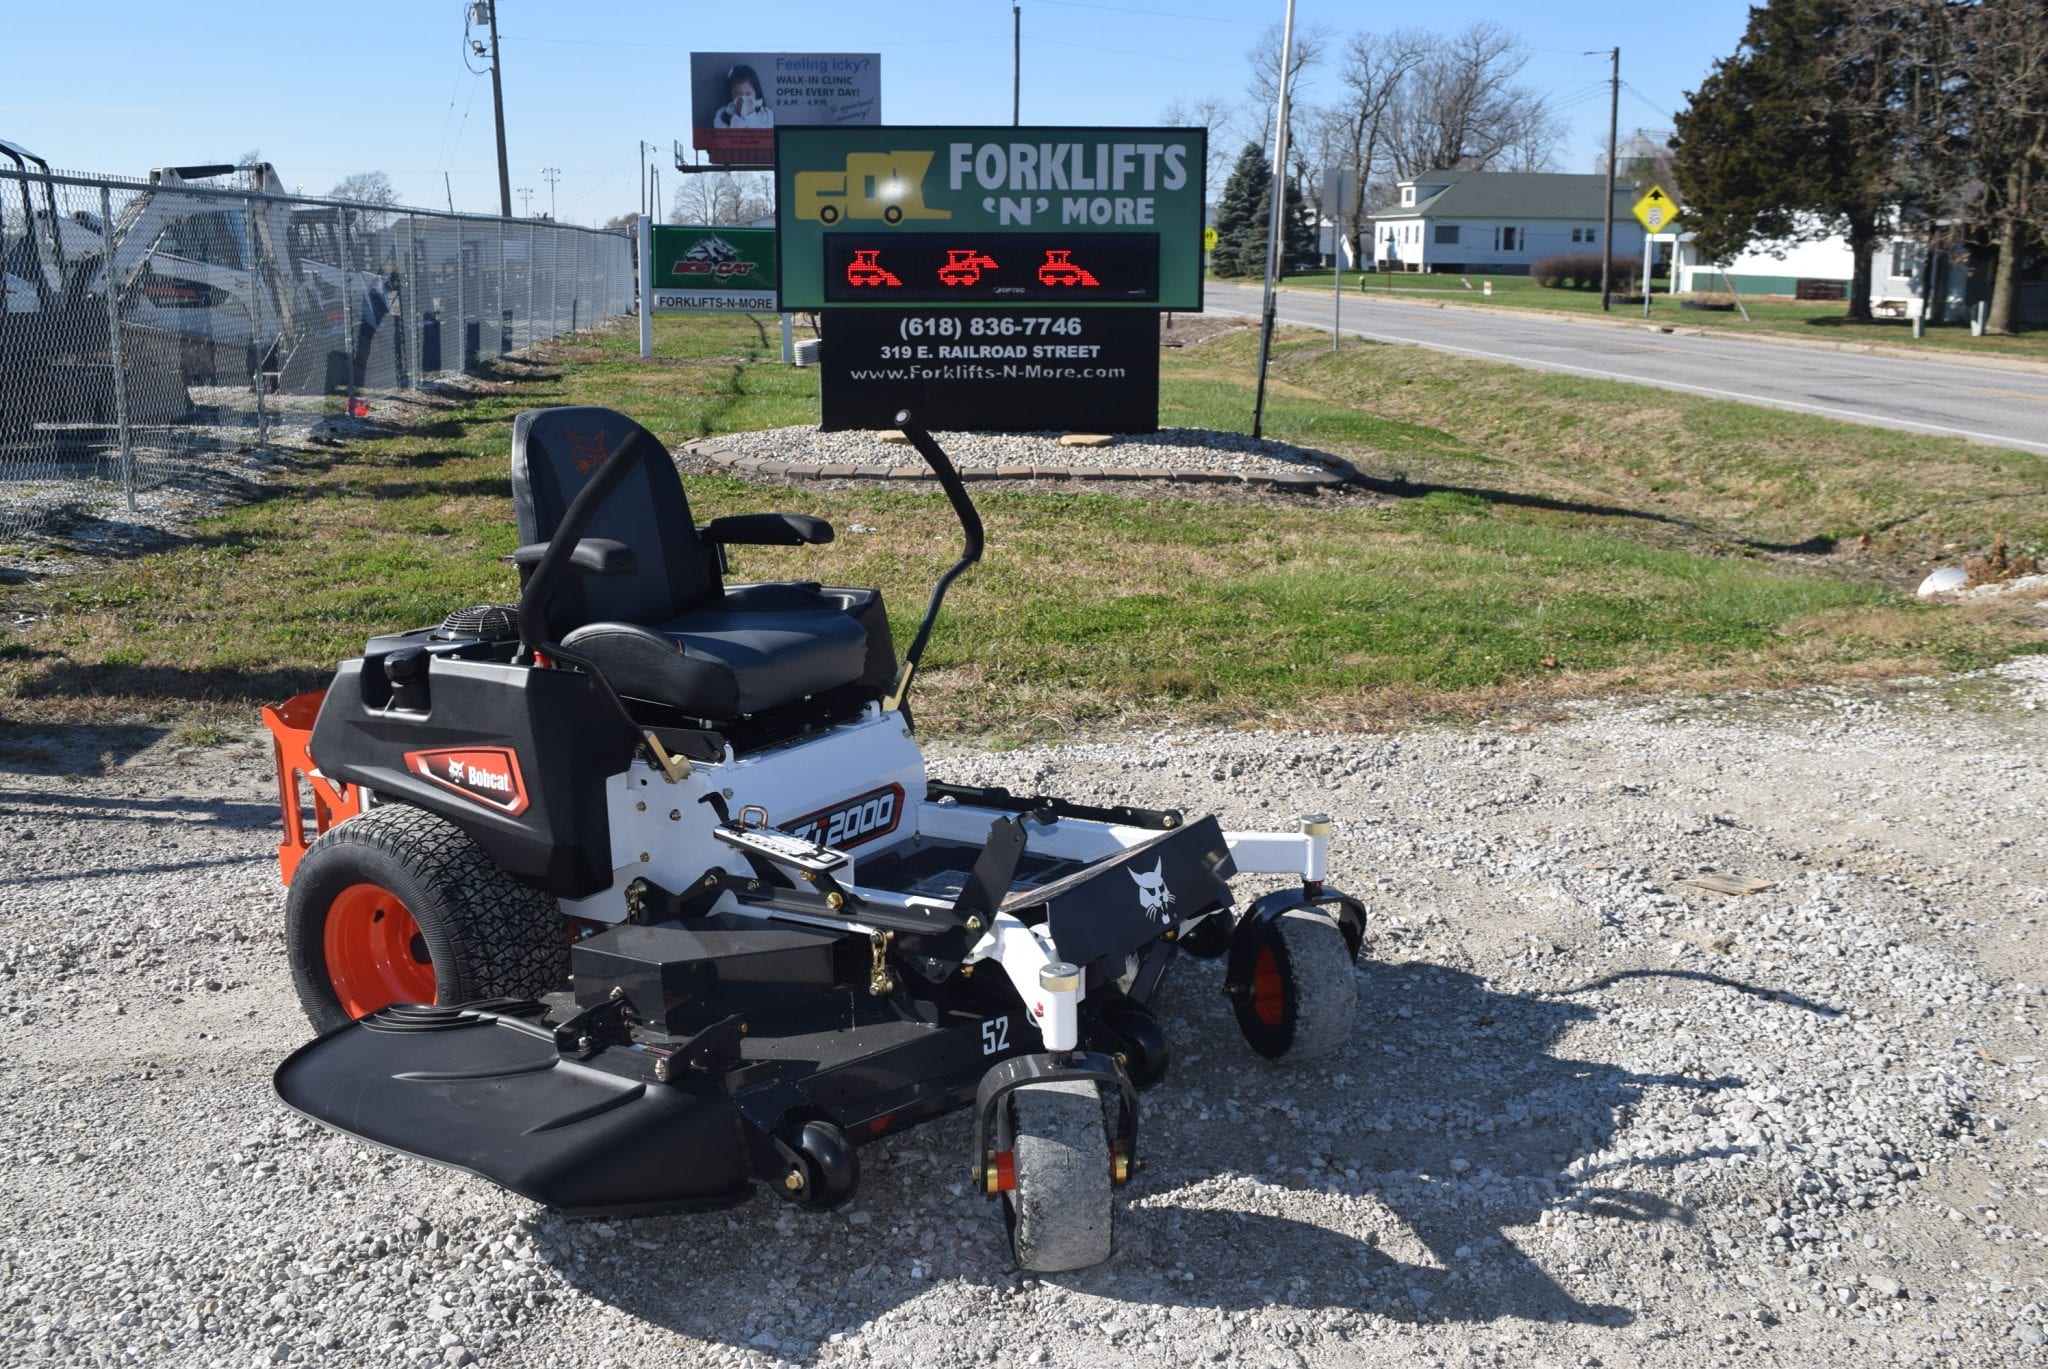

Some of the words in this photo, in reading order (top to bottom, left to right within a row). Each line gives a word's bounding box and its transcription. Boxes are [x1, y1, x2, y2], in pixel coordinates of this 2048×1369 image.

[776, 58, 828, 73] Feeling
[833, 58, 870, 73] icky?
[776, 76, 819, 84] WALK-IN
[822, 76, 853, 84] CLINIC
[776, 88, 803, 96] OPEN
[805, 88, 835, 96] EVERY
[837, 88, 860, 96] DAY!
[949, 143, 1187, 191] FORKLIFTS
[1062, 197, 1154, 225] MORE
[659, 296, 772, 309] FORKLIFTS-N-MORE
[900, 317, 962, 340] (618)
[970, 317, 1082, 336] 836-7746
[880, 346, 912, 359] 319
[917, 346, 934, 358] E.
[938, 345, 1027, 359] RAILROAD
[1032, 345, 1101, 358] STREET
[850, 364, 1126, 380] www.Forklifts-N-More.com
[468, 766, 509, 792] Bobcat
[982, 1016, 1010, 1056] 52
